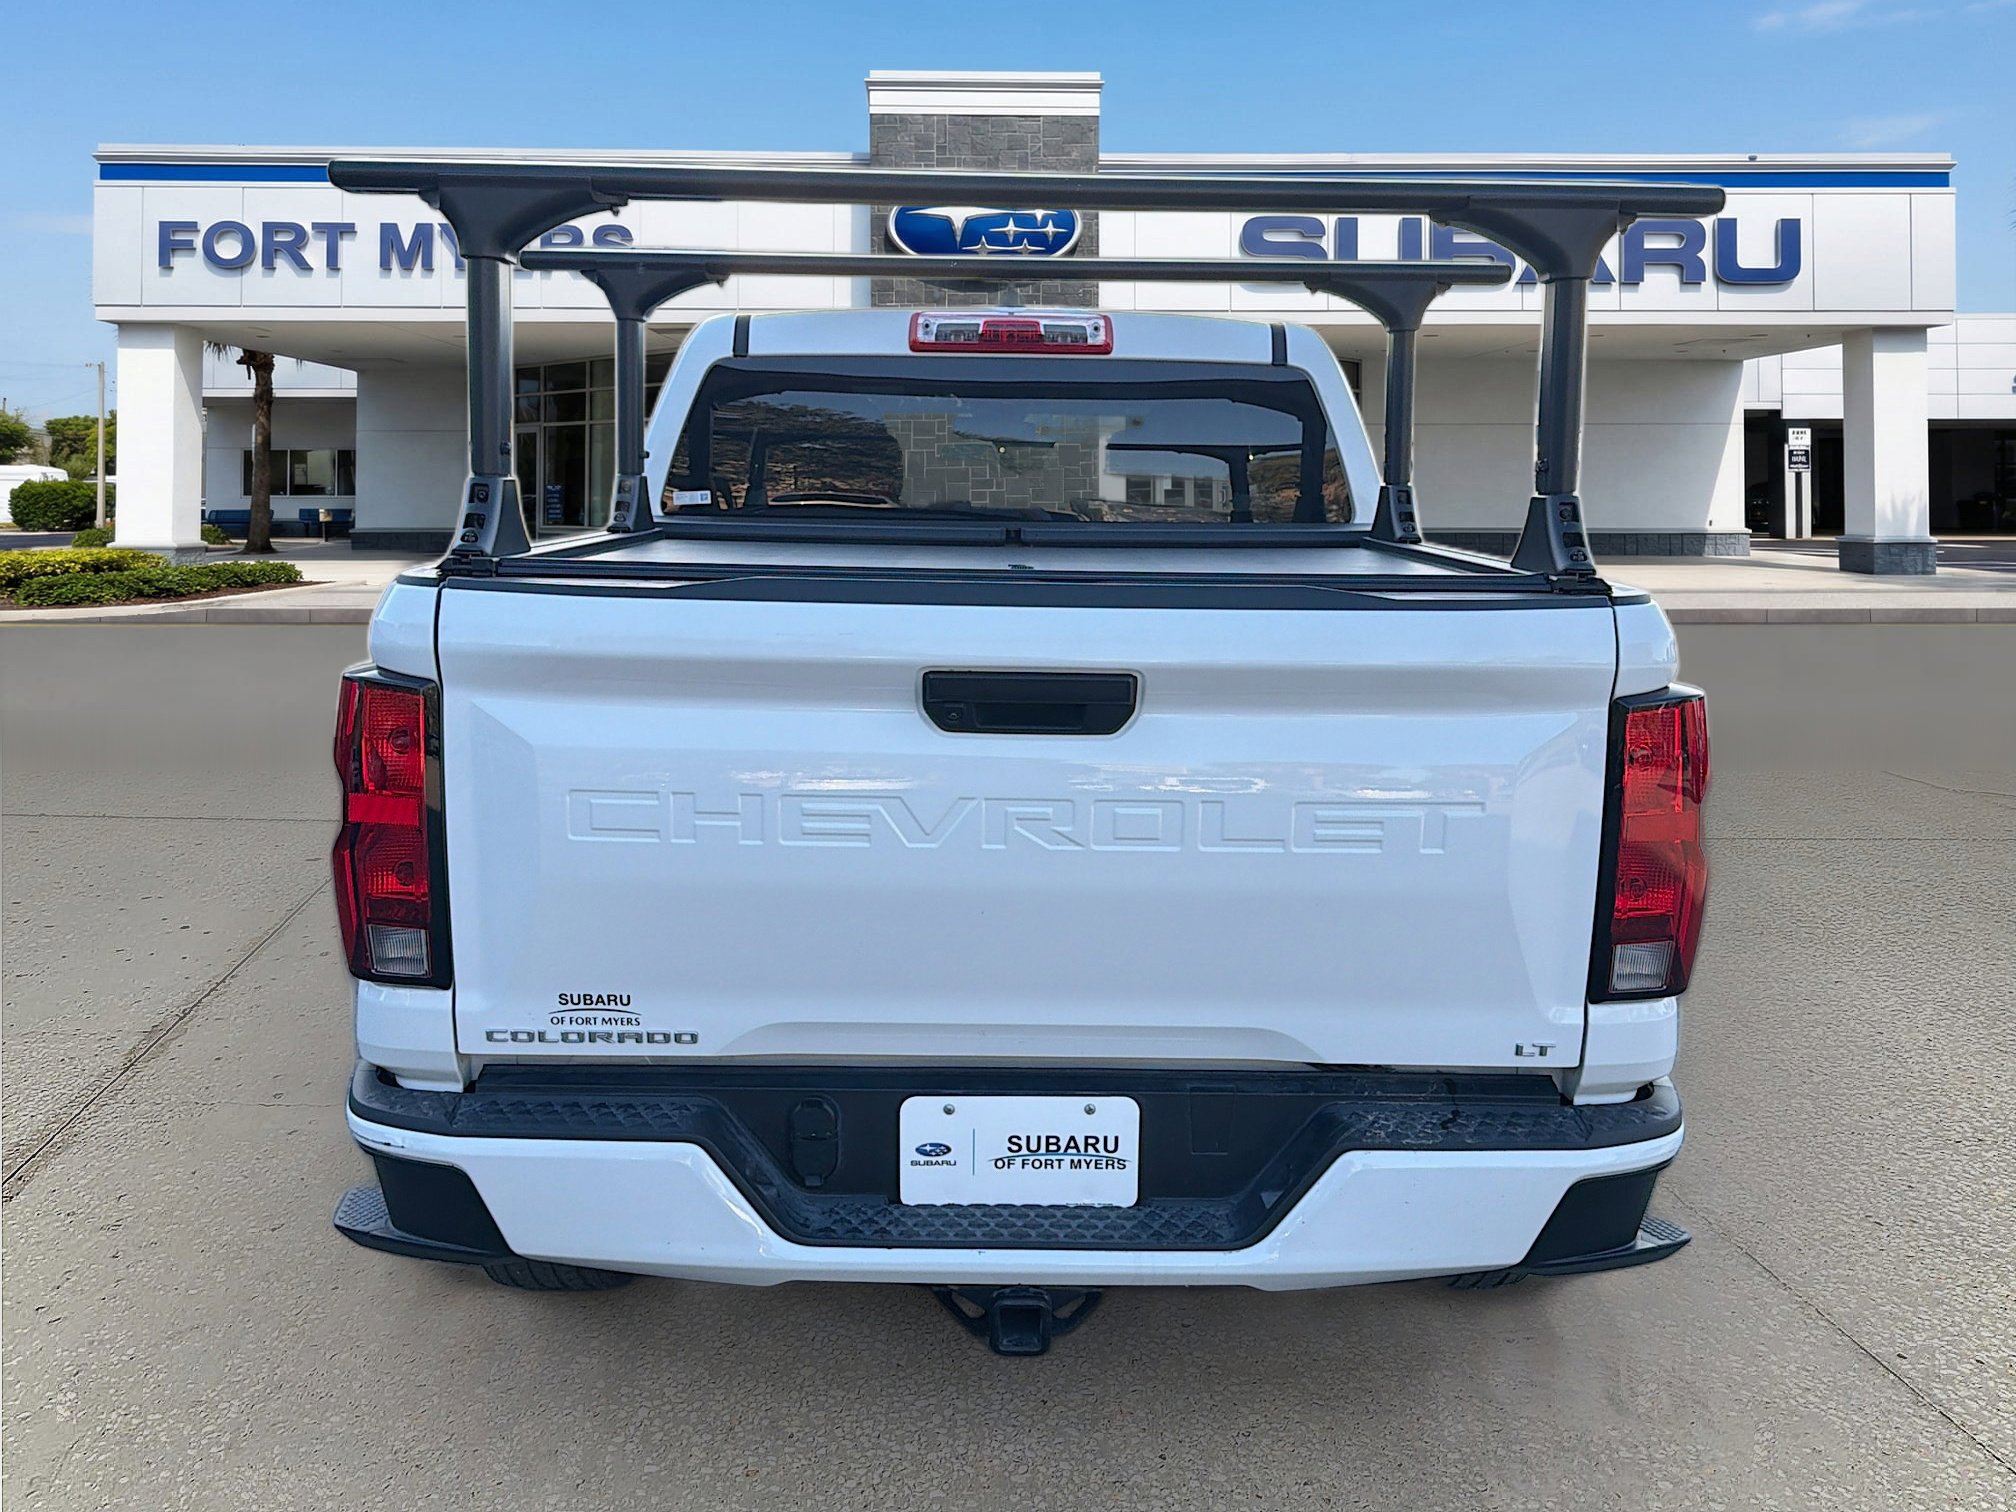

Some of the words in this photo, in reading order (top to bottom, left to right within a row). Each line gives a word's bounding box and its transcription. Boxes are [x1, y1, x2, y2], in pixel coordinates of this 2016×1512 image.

[157, 220, 356, 271] FORT
[379, 222, 634, 271] MRS
[1239, 215, 1801, 285] SUBRU
[567, 789, 1486, 854] CHEVROLET
[558, 993, 631, 1007] SUBARU
[550, 1016, 567, 1026] OF
[569, 1016, 599, 1026] FORT
[601, 1017, 641, 1027] MYERS
[485, 1029, 699, 1045] COLORADO
[1514, 1042, 1556, 1057] LT
[1007, 1135, 1120, 1154] SUBARU
[994, 1158, 1015, 1170] OF
[1021, 1158, 1064, 1170] FORT
[1069, 1158, 1127, 1170] MYERS
